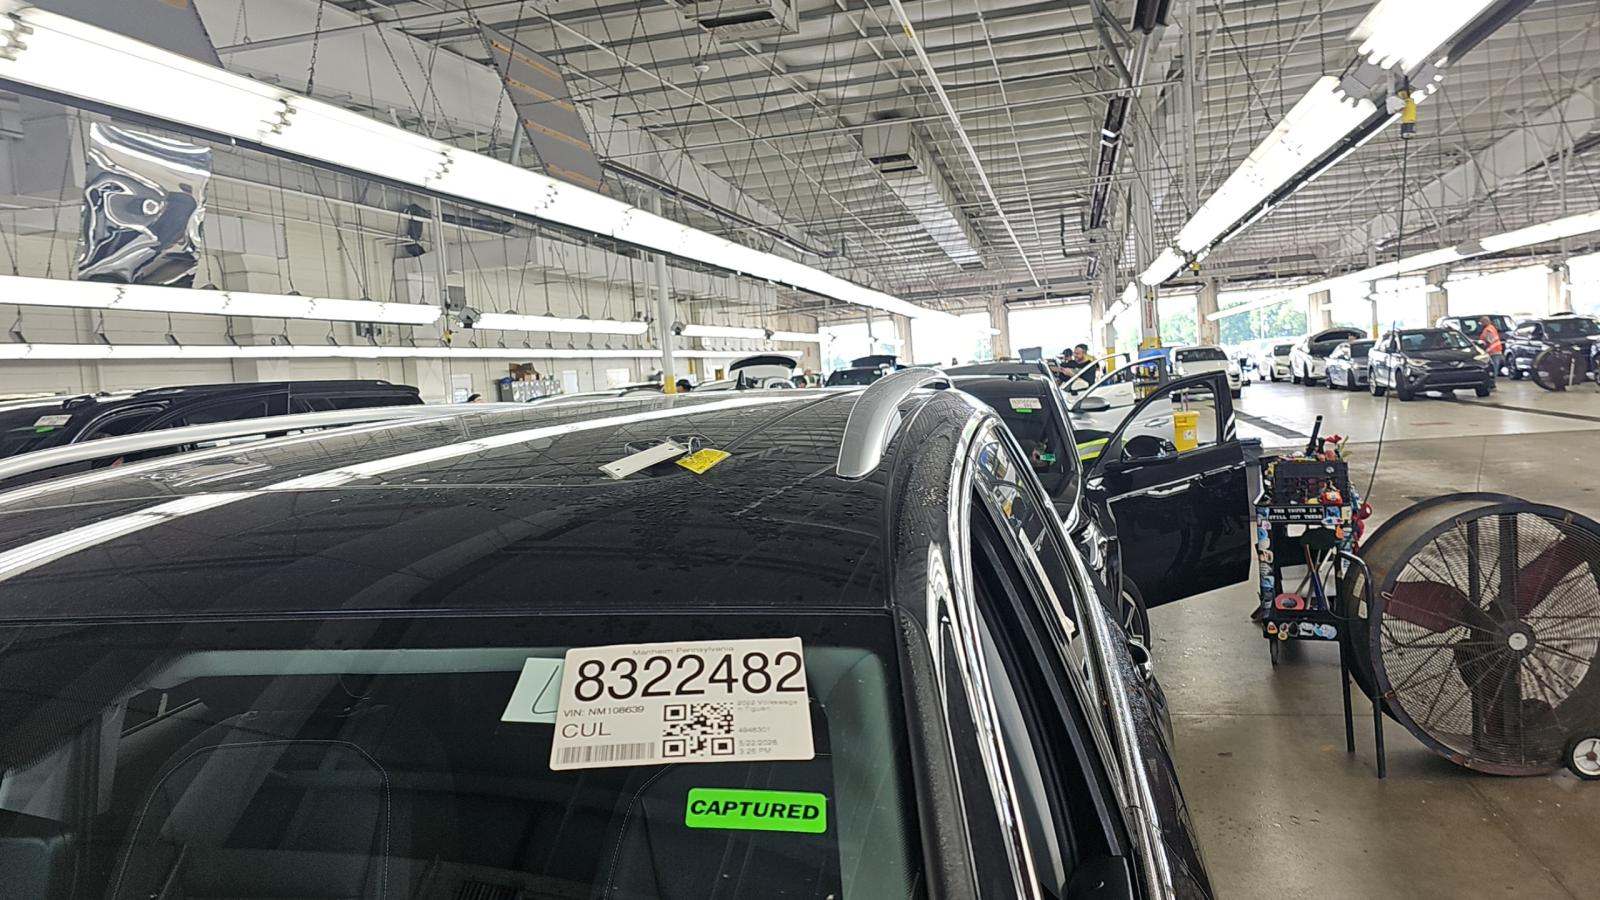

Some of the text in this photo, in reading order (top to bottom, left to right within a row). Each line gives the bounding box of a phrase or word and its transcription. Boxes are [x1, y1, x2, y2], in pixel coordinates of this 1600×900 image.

[676, 646, 735, 654] Pennsylvania
[573, 650, 806, 702] 8322482
[563, 708, 584, 718] VIN:
[562, 722, 612, 739] CUL
[690, 799, 820, 820] CAPTURED
